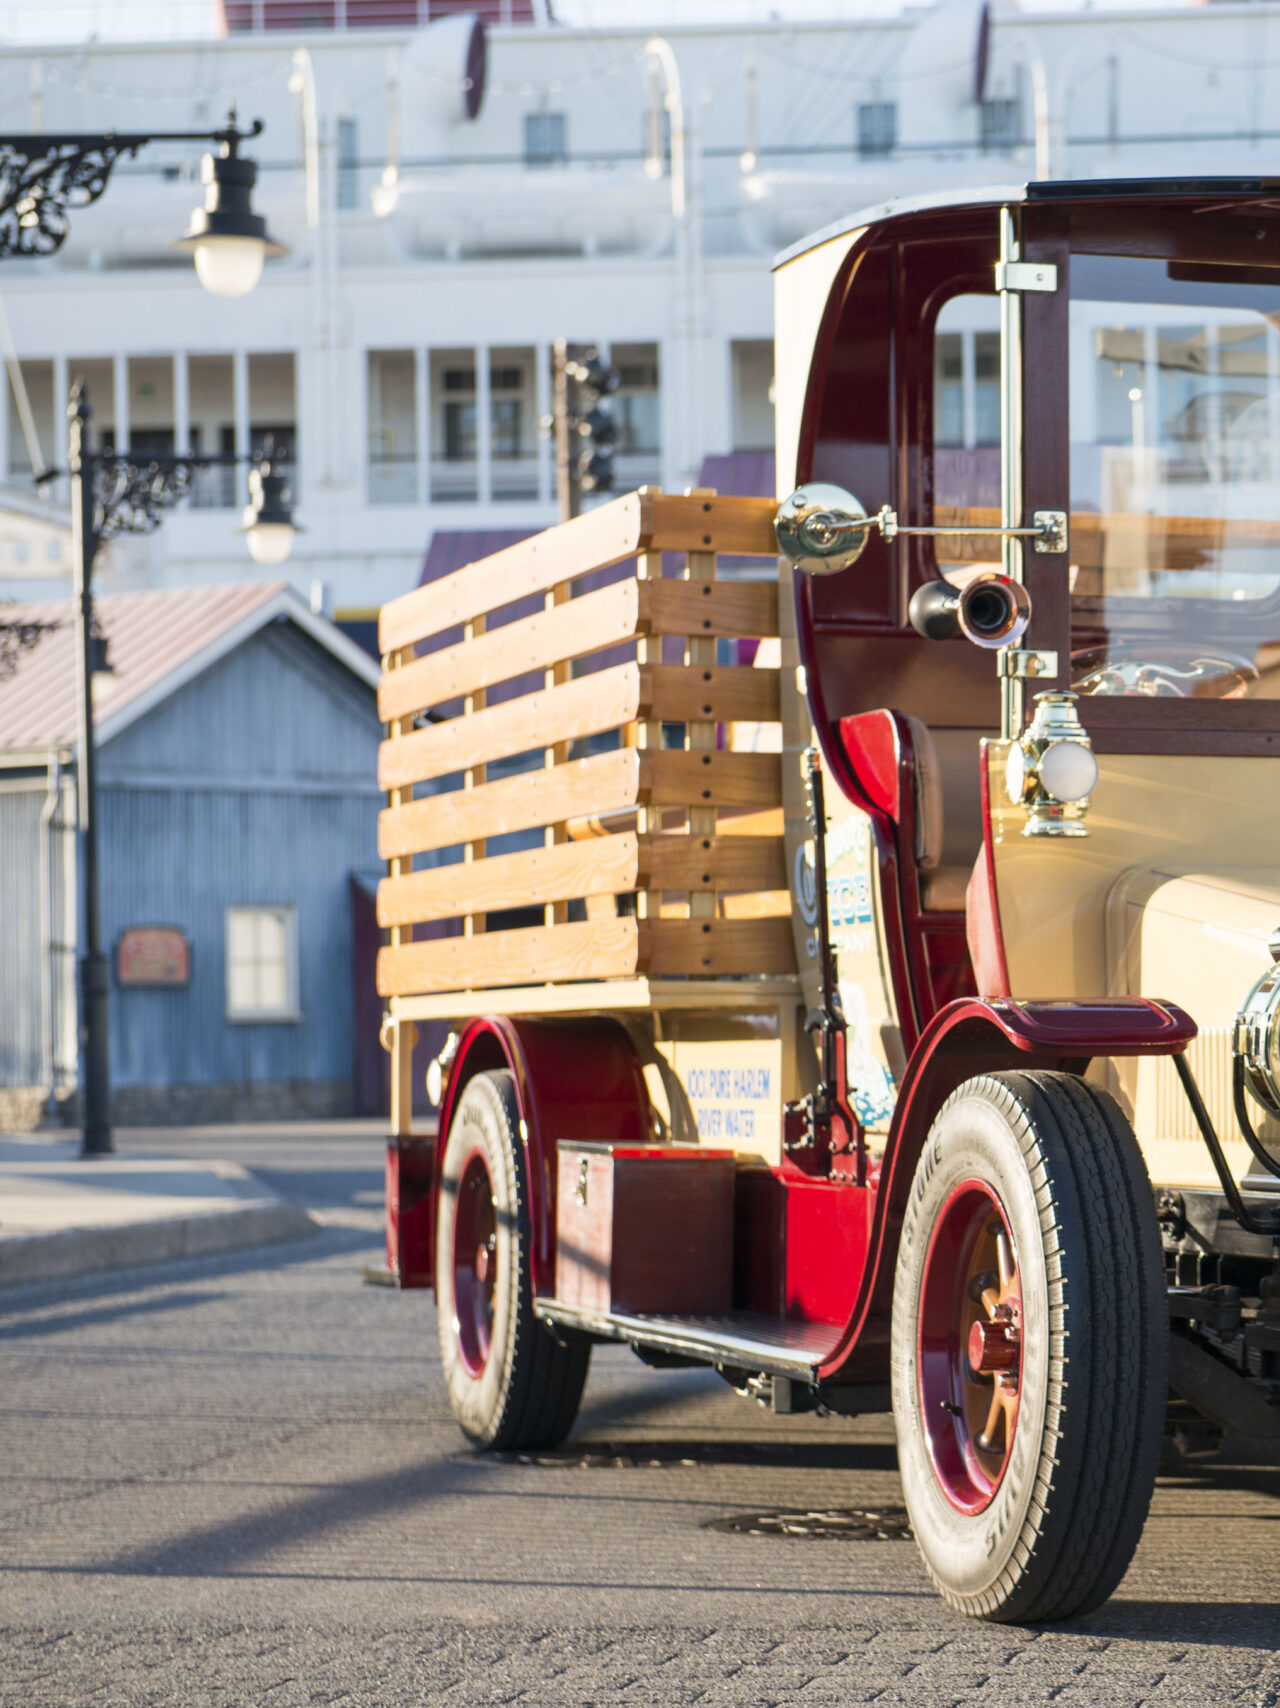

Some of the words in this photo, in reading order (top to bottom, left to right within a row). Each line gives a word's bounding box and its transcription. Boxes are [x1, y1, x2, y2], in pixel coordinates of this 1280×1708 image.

[826, 868, 872, 921] ICE
[710, 1068, 732, 1098] PURE
[734, 1068, 770, 1099] HARLEM
[698, 1108, 721, 1137] RIVER
[725, 1108, 756, 1138] WATER
